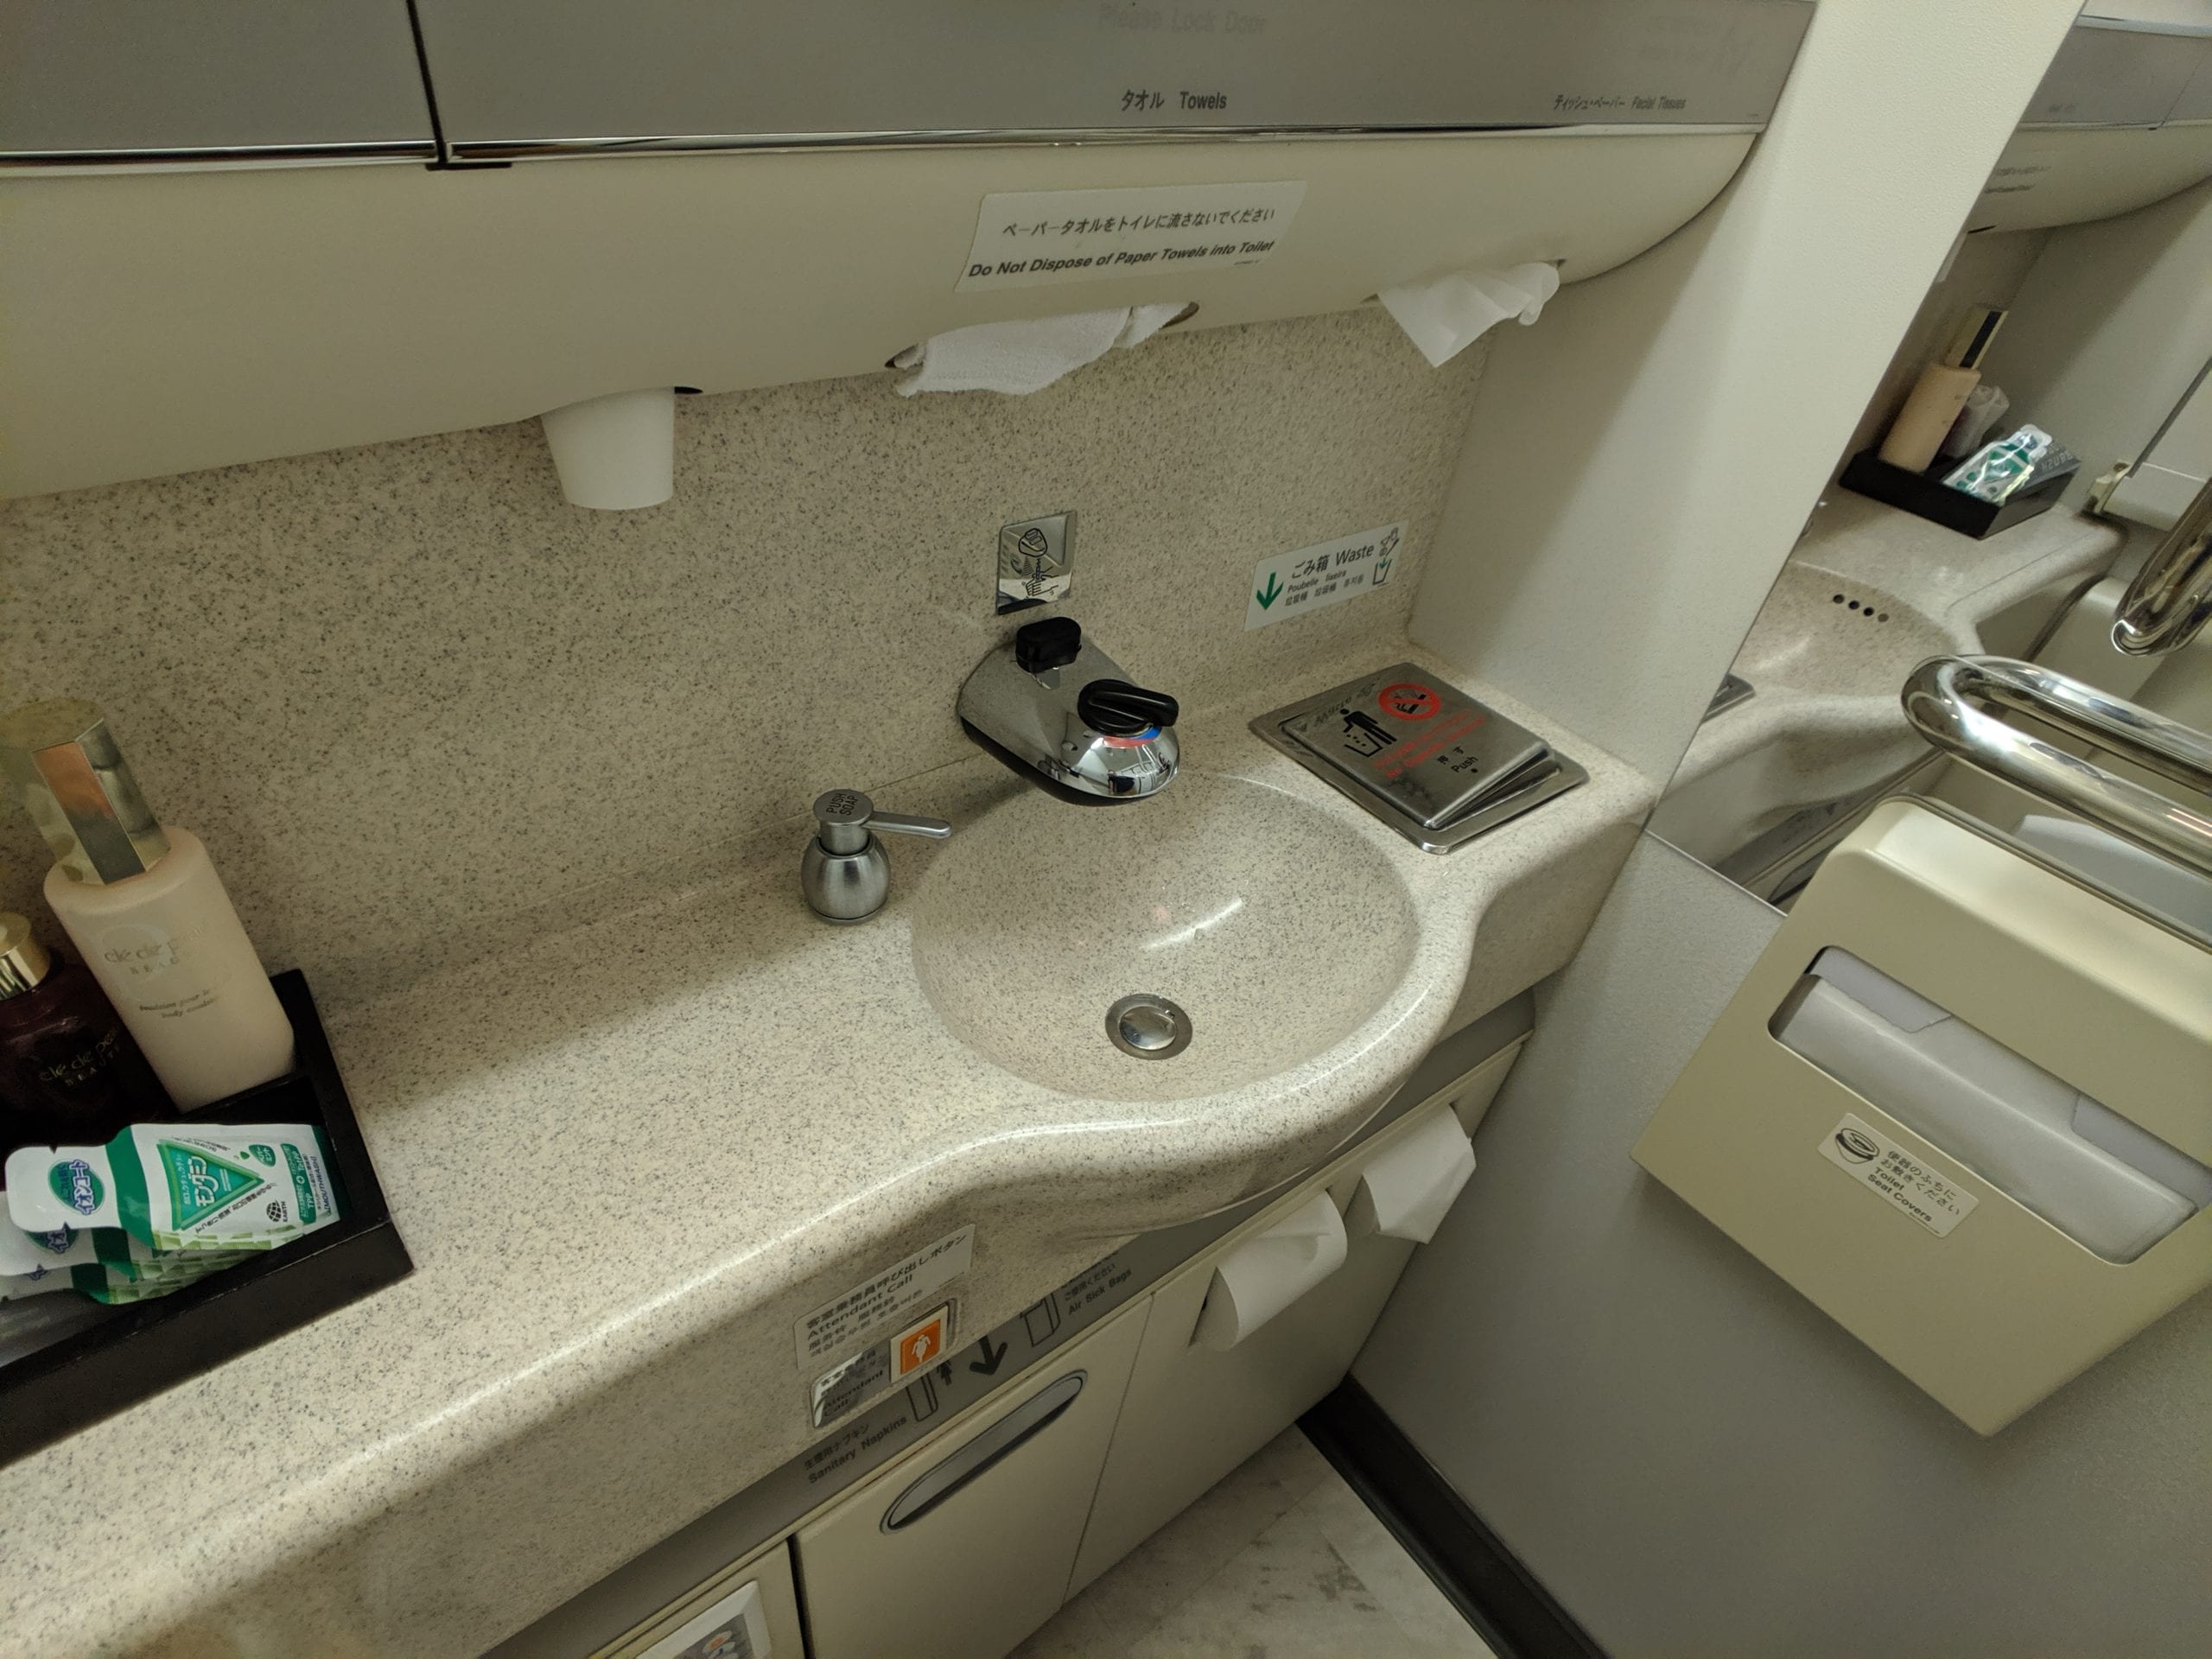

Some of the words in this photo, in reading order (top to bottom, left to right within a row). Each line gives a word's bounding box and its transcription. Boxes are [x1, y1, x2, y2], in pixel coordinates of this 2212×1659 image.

[1122, 90, 1165, 111] タオル
[1179, 91, 1227, 111] Towels
[1002, 209, 1275, 236] ペーパータオルをトイレに流さないでください
[968, 264, 992, 277] Do
[996, 260, 1027, 275] Not
[1029, 256, 1093, 272] Dispose
[1096, 253, 1115, 266] of
[1115, 249, 1159, 266] Paper
[1161, 245, 1208, 261] Towels
[1211, 243, 1236, 256] into
[1239, 240, 1275, 254] Toilet
[1336, 545, 1374, 566] Waste
[1452, 756, 1478, 772] Push
[826, 792, 847, 814] PUSH
[839, 795, 859, 816] SOAP
[69, 1159, 96, 1215] イオンコート
[188, 1155, 219, 1207] モンダミン
[1874, 1166, 1905, 1191] Toilet
[1867, 1173, 1892, 1194] Seat
[1893, 1192, 1932, 1222] Covers
[1069, 1301, 1082, 1314] Air
[1086, 1286, 1106, 1303] Sick
[1109, 1269, 1131, 1287] Bags
[807, 1293, 882, 1340] Attendant
[887, 1274, 912, 1294] Call
[808, 1449, 856, 1484] Sanitary
[861, 1416, 906, 1450] Napkins
